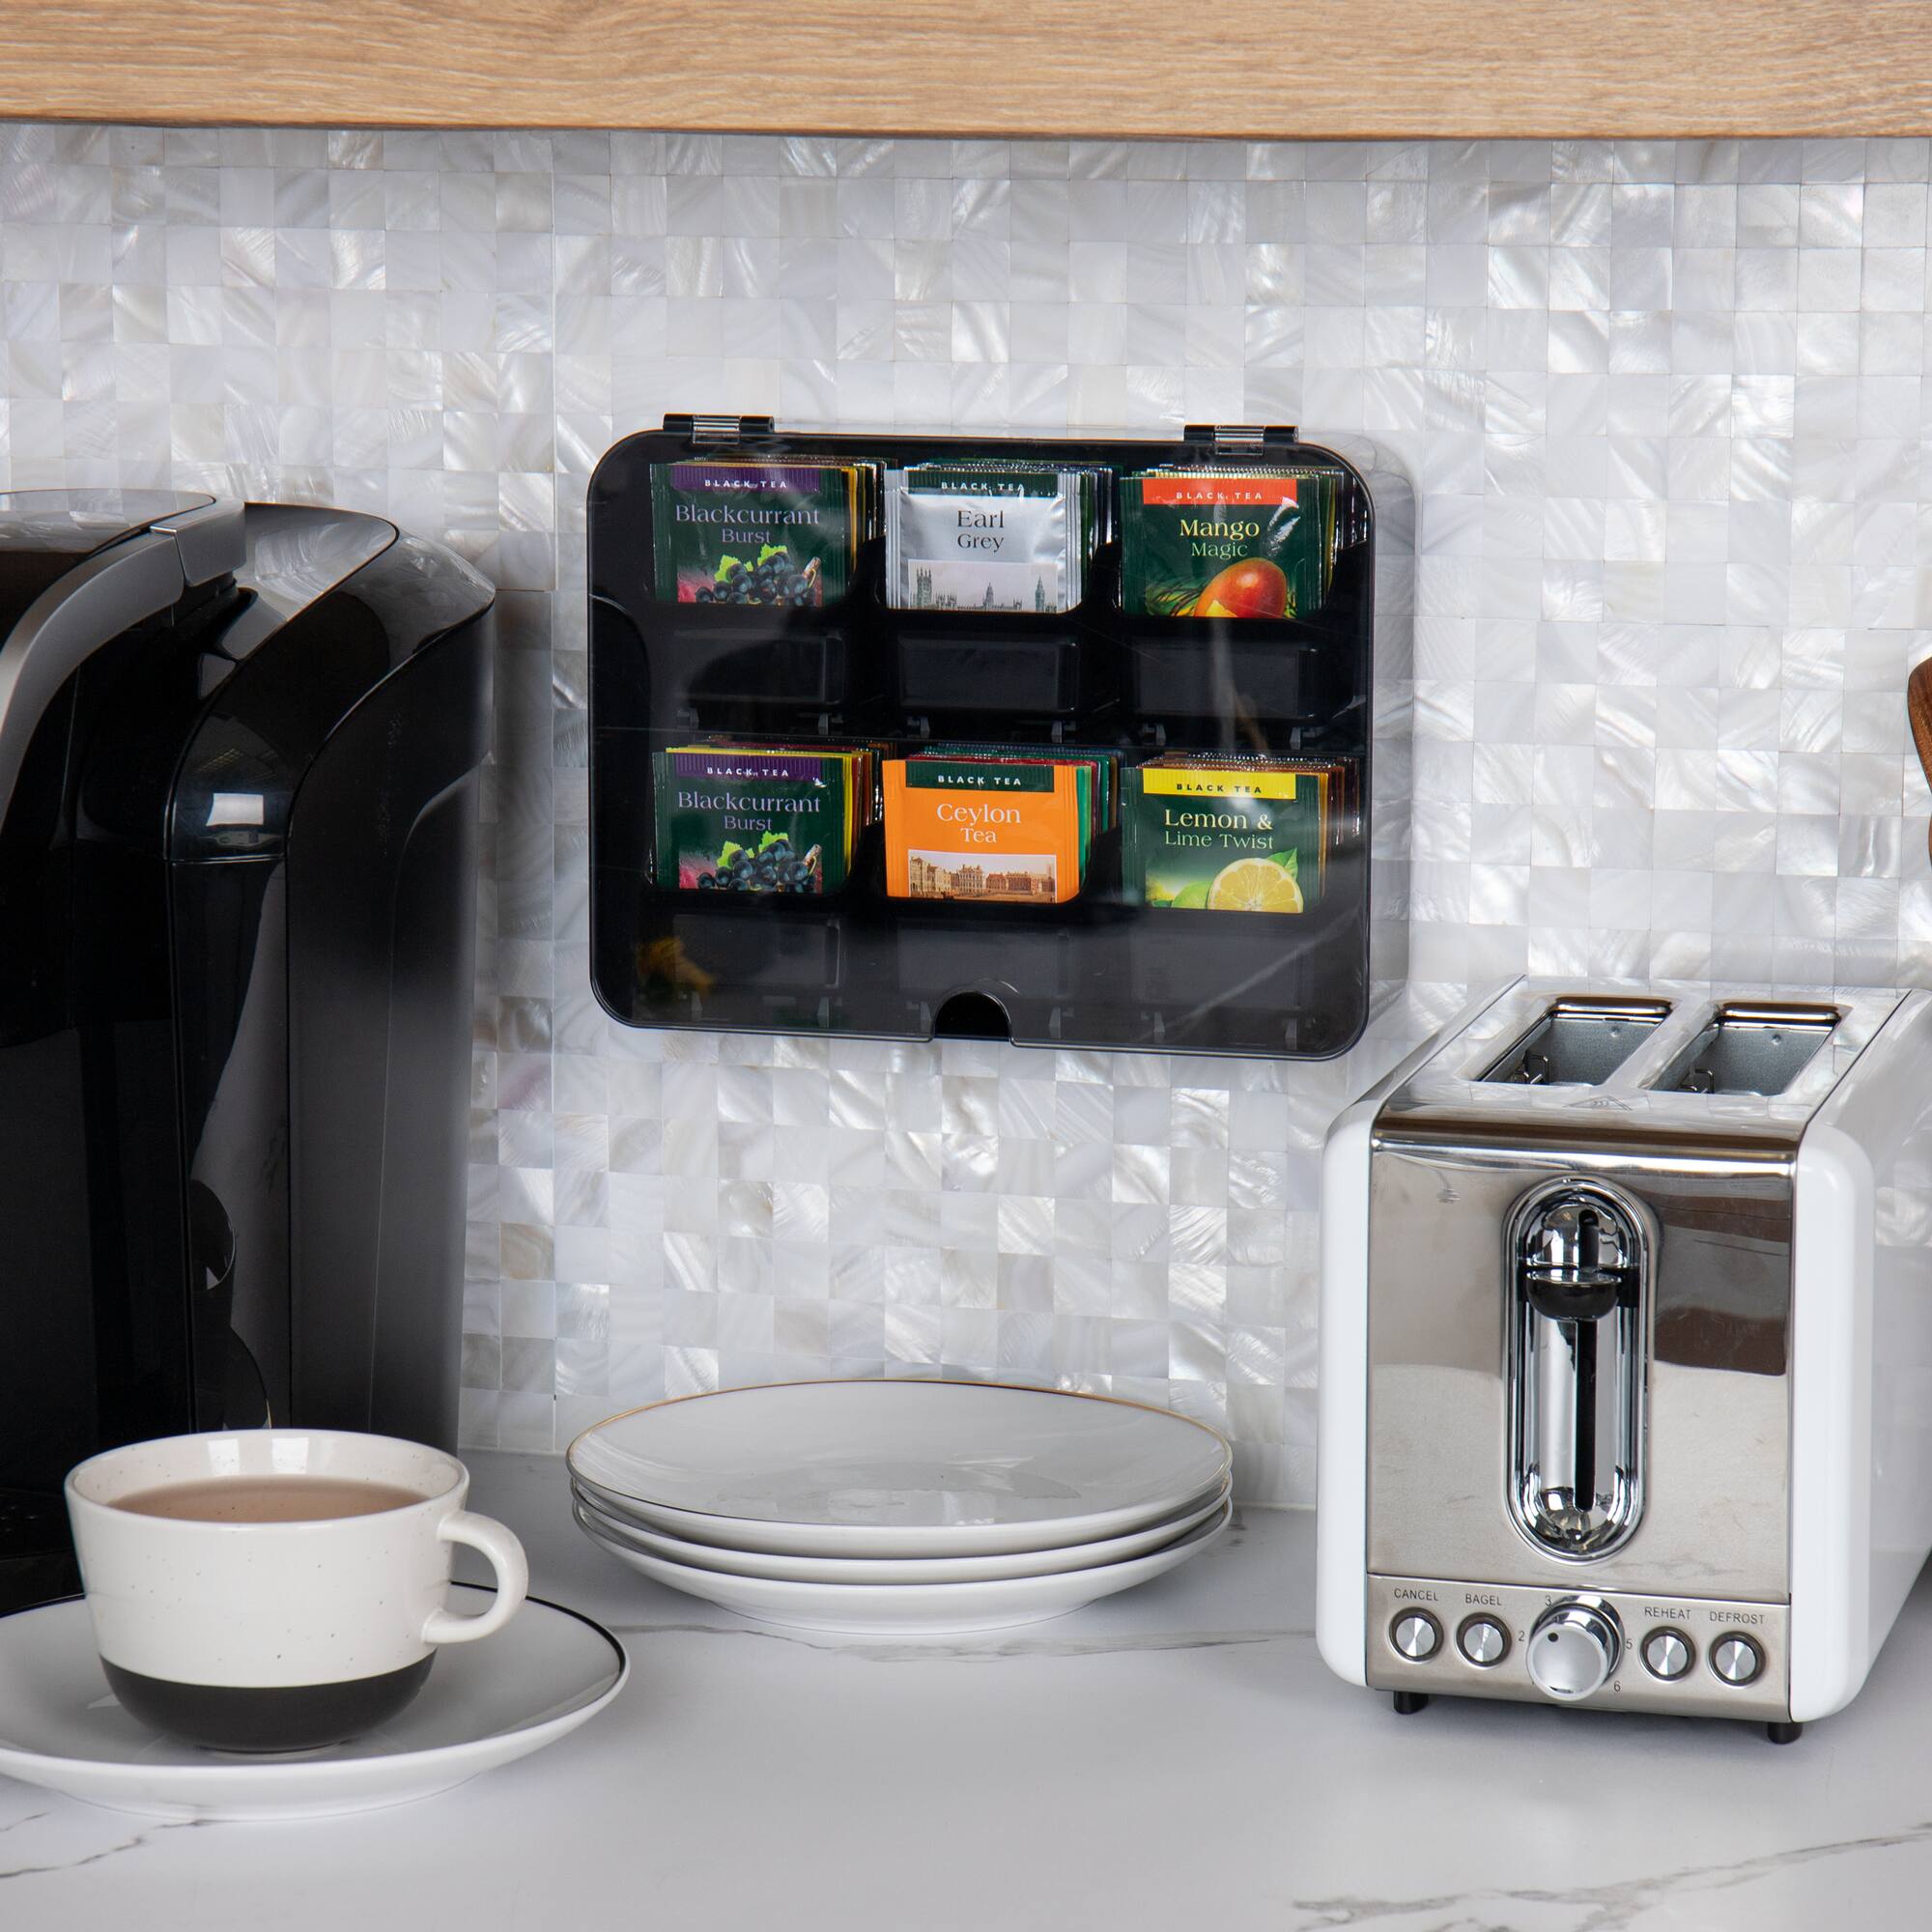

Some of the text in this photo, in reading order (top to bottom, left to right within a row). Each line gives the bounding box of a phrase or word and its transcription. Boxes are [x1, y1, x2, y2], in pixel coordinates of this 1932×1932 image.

[704, 479, 787, 489] BLACK TEA
[941, 482, 1024, 492] BLACK TEA
[1235, 492, 1263, 500] TEA
[675, 503, 820, 526] Blackcurrant
[956, 509, 1005, 528] Earl
[721, 528, 771, 544] Burst
[1179, 519, 1260, 541] Mango
[956, 533, 1005, 554] Grey
[1191, 542, 1248, 560] Magic
[706, 767, 789, 778] BLACK TEA
[937, 775, 1022, 786] BLACK TEA
[1176, 783, 1262, 794] BLACK TEA
[677, 790, 821, 812] Blackcurrant
[936, 803, 1021, 826] Ceylon
[1164, 809, 1273, 831] Lemon &
[724, 814, 773, 832] Burst
[960, 827, 997, 843] Tea
[1164, 830, 1274, 850] Lime Twist
[1394, 1587, 1439, 1602] CANCEL
[1464, 1593, 1502, 1606] BAGEL
[1545, 1595, 1552, 1607] 3
[1644, 1605, 1691, 1621] REHEAT
[1709, 1610, 1766, 1625] DEFROST
[1518, 1630, 1525, 1642] 2
[1625, 1638, 1634, 1650] 5
[1613, 1681, 1621, 1692] 6
